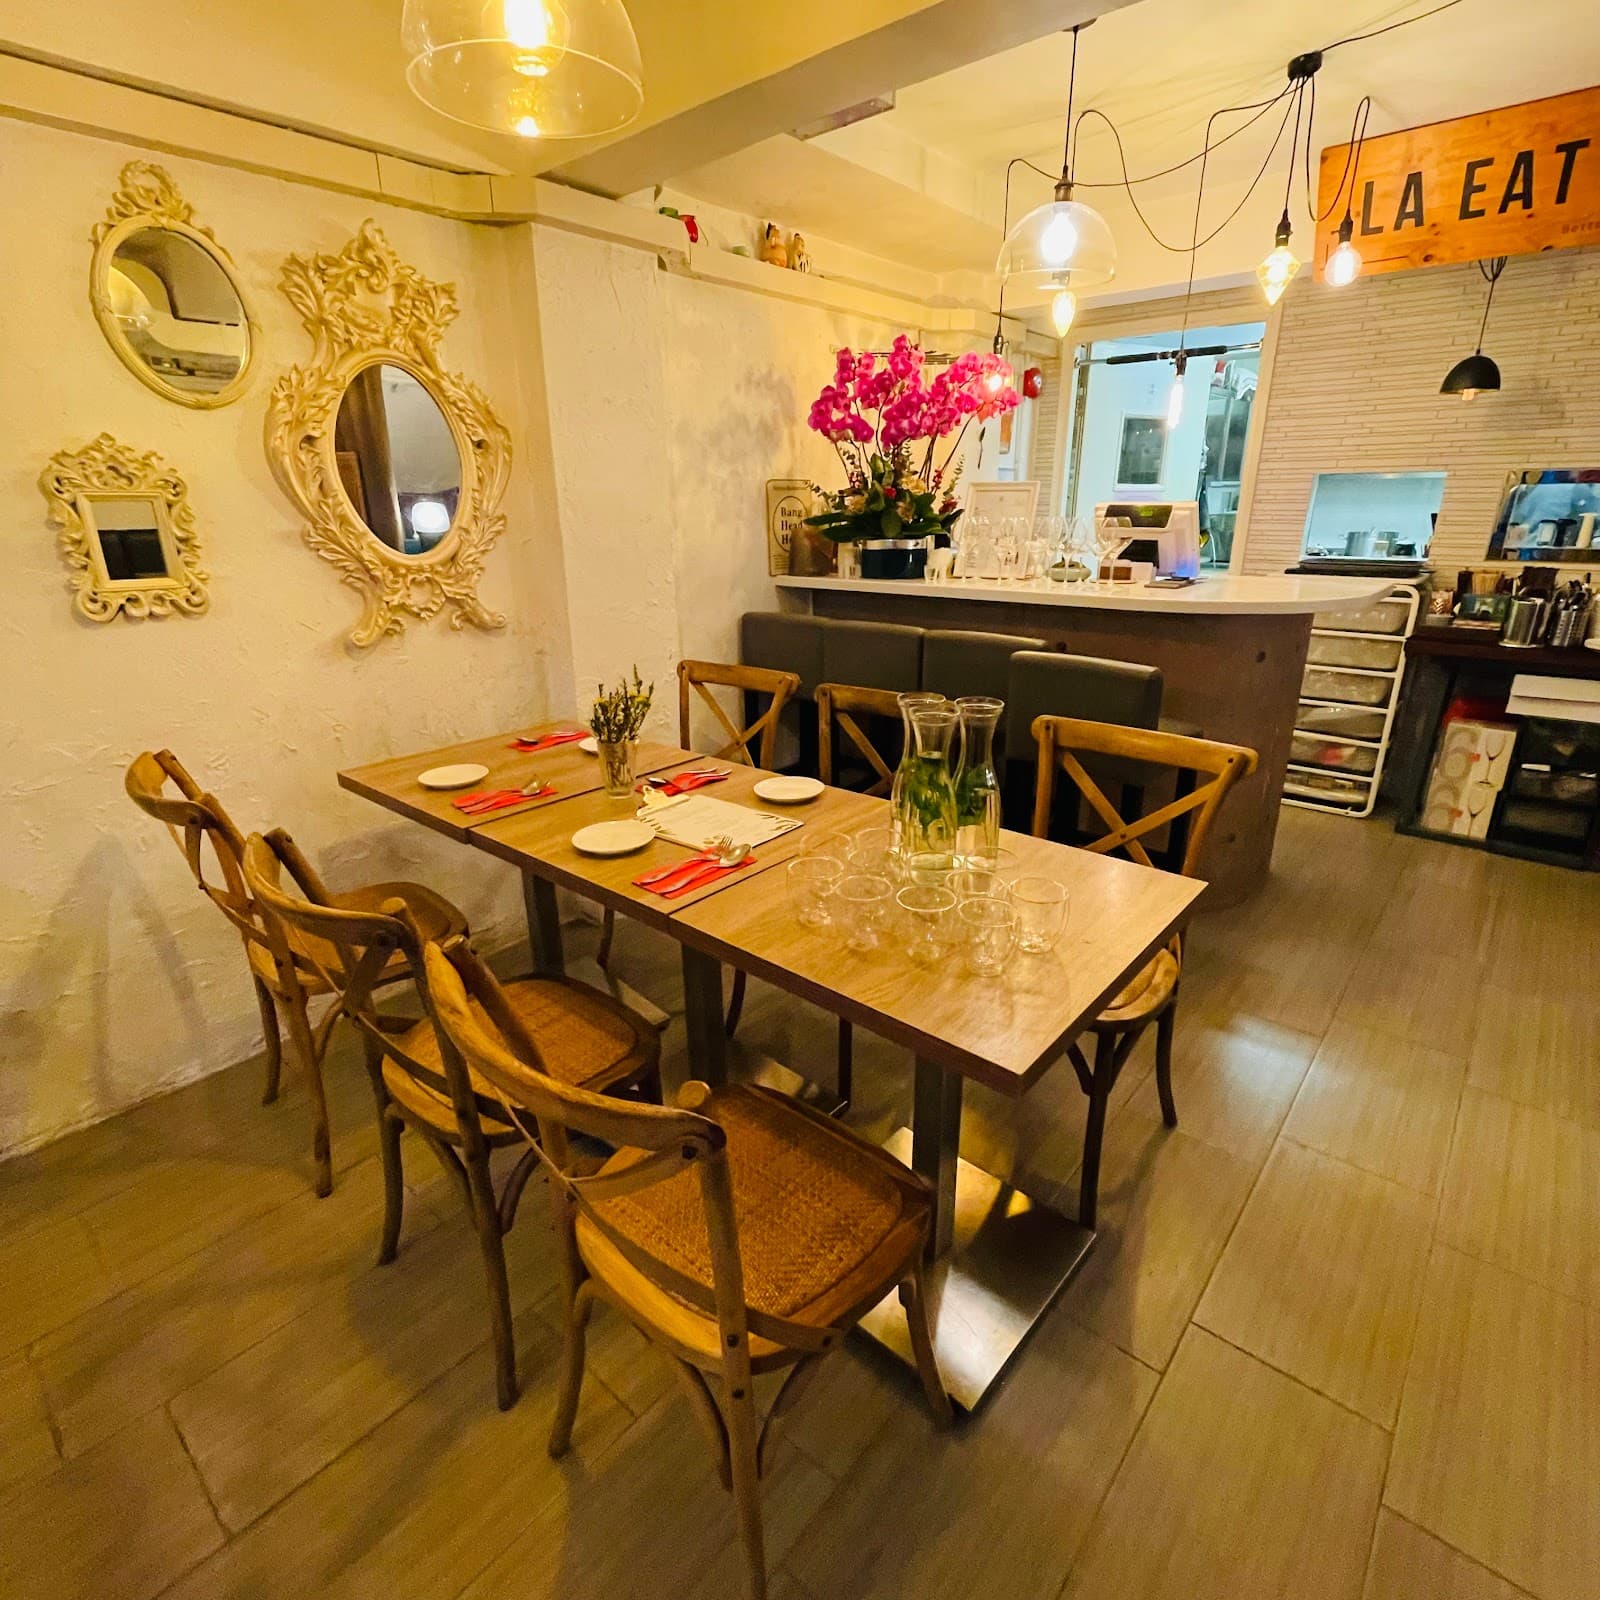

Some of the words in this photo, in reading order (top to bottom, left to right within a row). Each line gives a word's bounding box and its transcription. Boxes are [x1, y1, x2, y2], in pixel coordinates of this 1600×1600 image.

[1360, 171, 1425, 236] LA
[1458, 138, 1591, 221] EAT
[780, 506, 803, 518] Bang
[780, 519, 803, 531] Head
